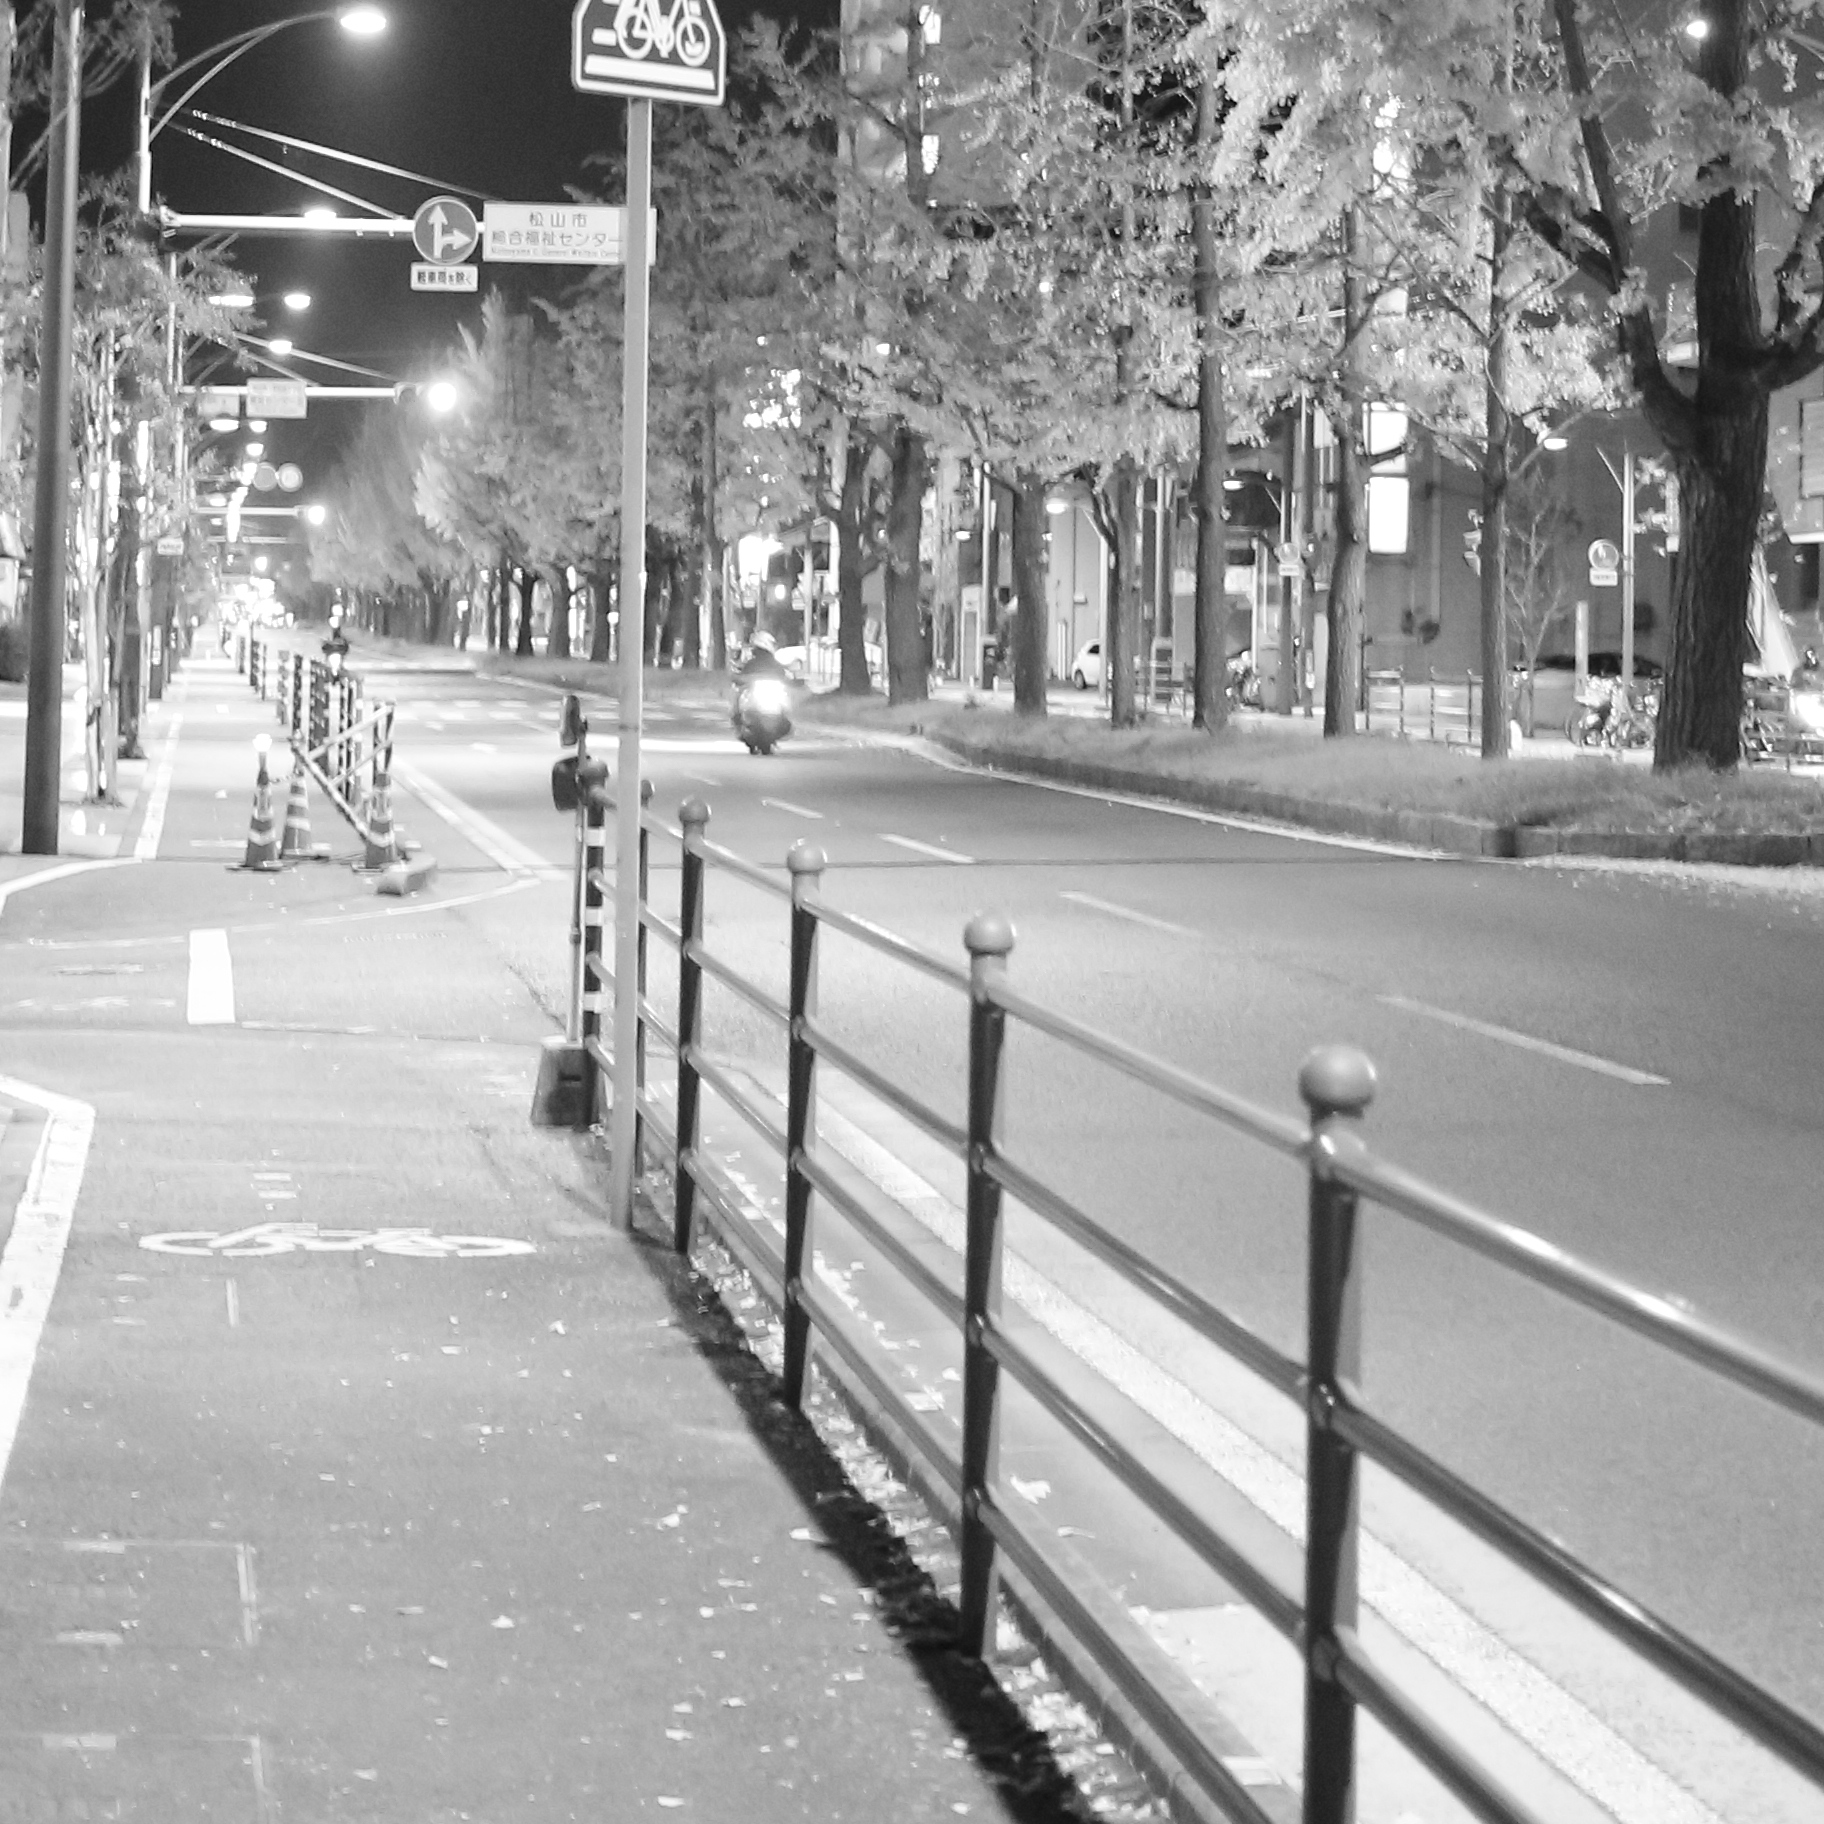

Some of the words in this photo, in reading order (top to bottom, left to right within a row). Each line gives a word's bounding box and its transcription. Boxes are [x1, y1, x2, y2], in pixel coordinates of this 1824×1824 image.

[529, 213, 588, 228] 松山市
[492, 230, 624, 247] 総合福祉センター
